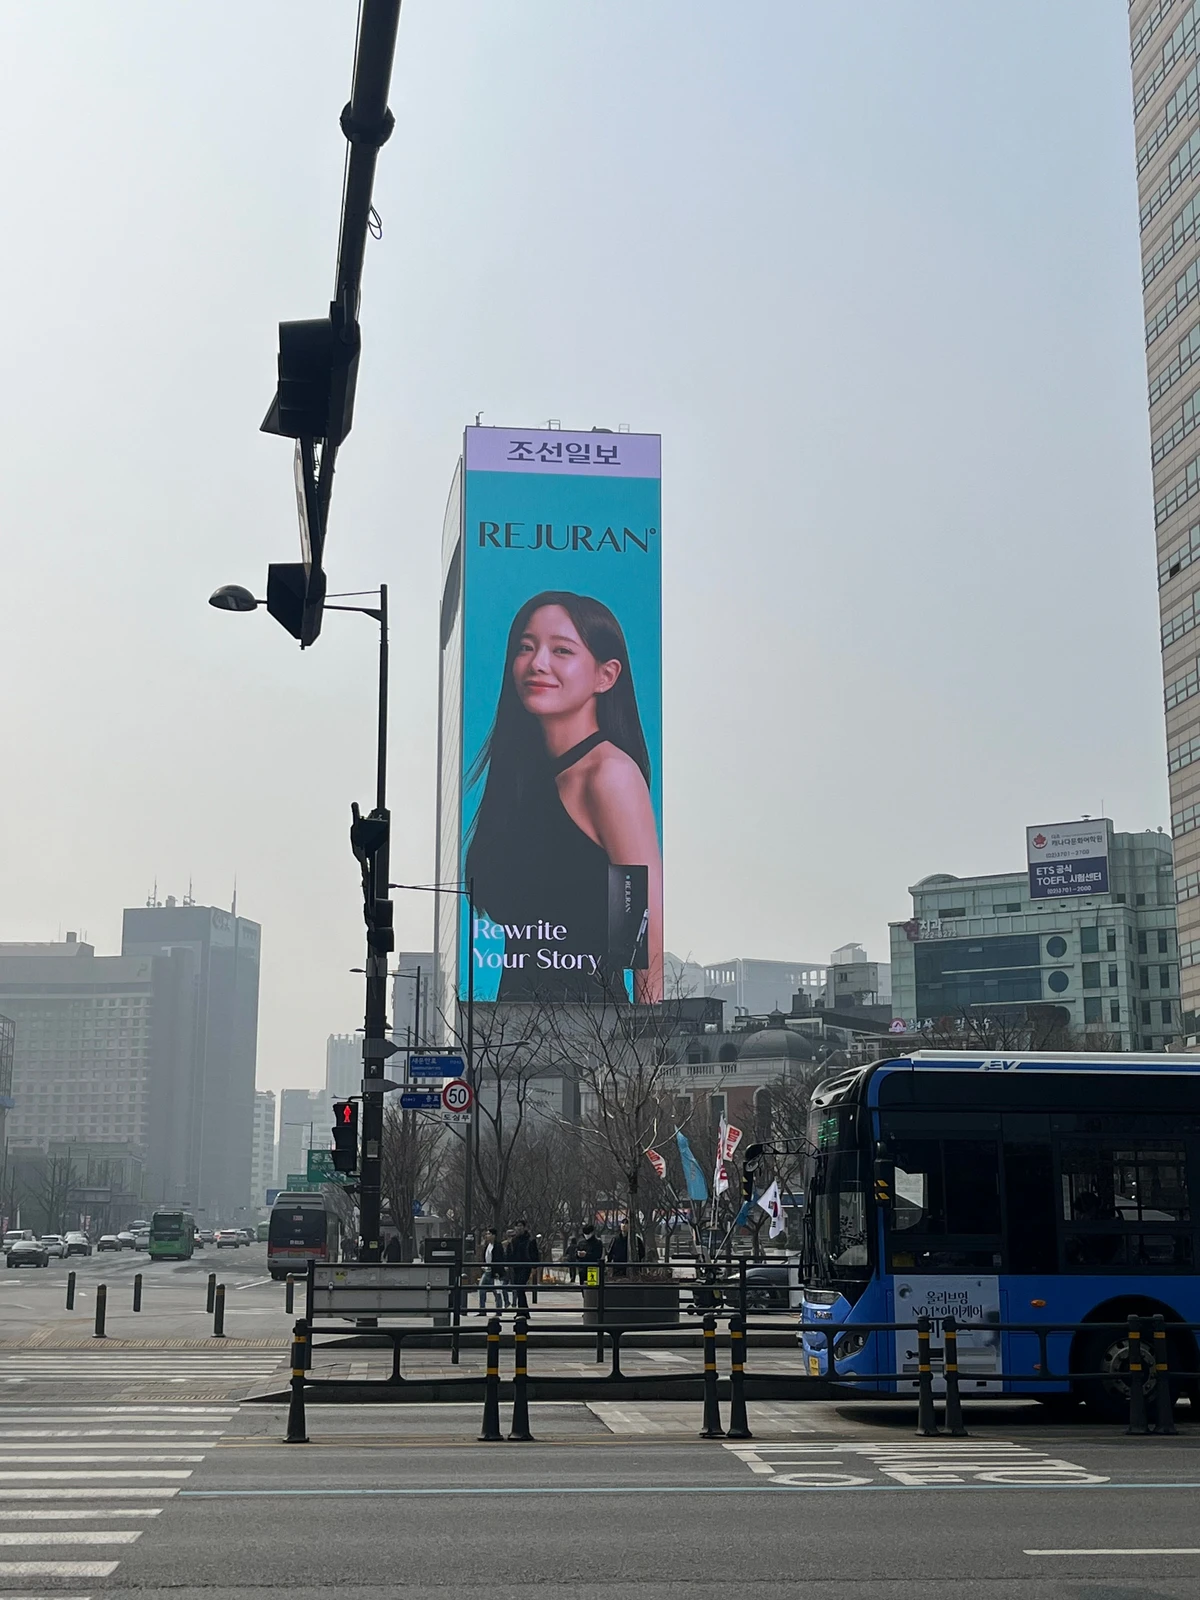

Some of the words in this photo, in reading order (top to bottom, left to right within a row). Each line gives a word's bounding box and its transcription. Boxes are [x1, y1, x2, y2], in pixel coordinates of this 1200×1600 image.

[507, 440, 621, 466] 조선일보
[1051, 835, 1103, 847] 캐나다문화어학원
[1036, 866, 1055, 876] ETS
[1056, 864, 1072, 874] 공식
[1036, 876, 1068, 886] TOEFL
[1069, 872, 1102, 883] 시험센터
[474, 919, 567, 941] Rewrite
[920, 918, 943, 932] 치과
[473, 948, 531, 970] Your
[536, 947, 602, 976] Story
[986, 1060, 1016, 1071] EV
[449, 1089, 466, 1104] 50
